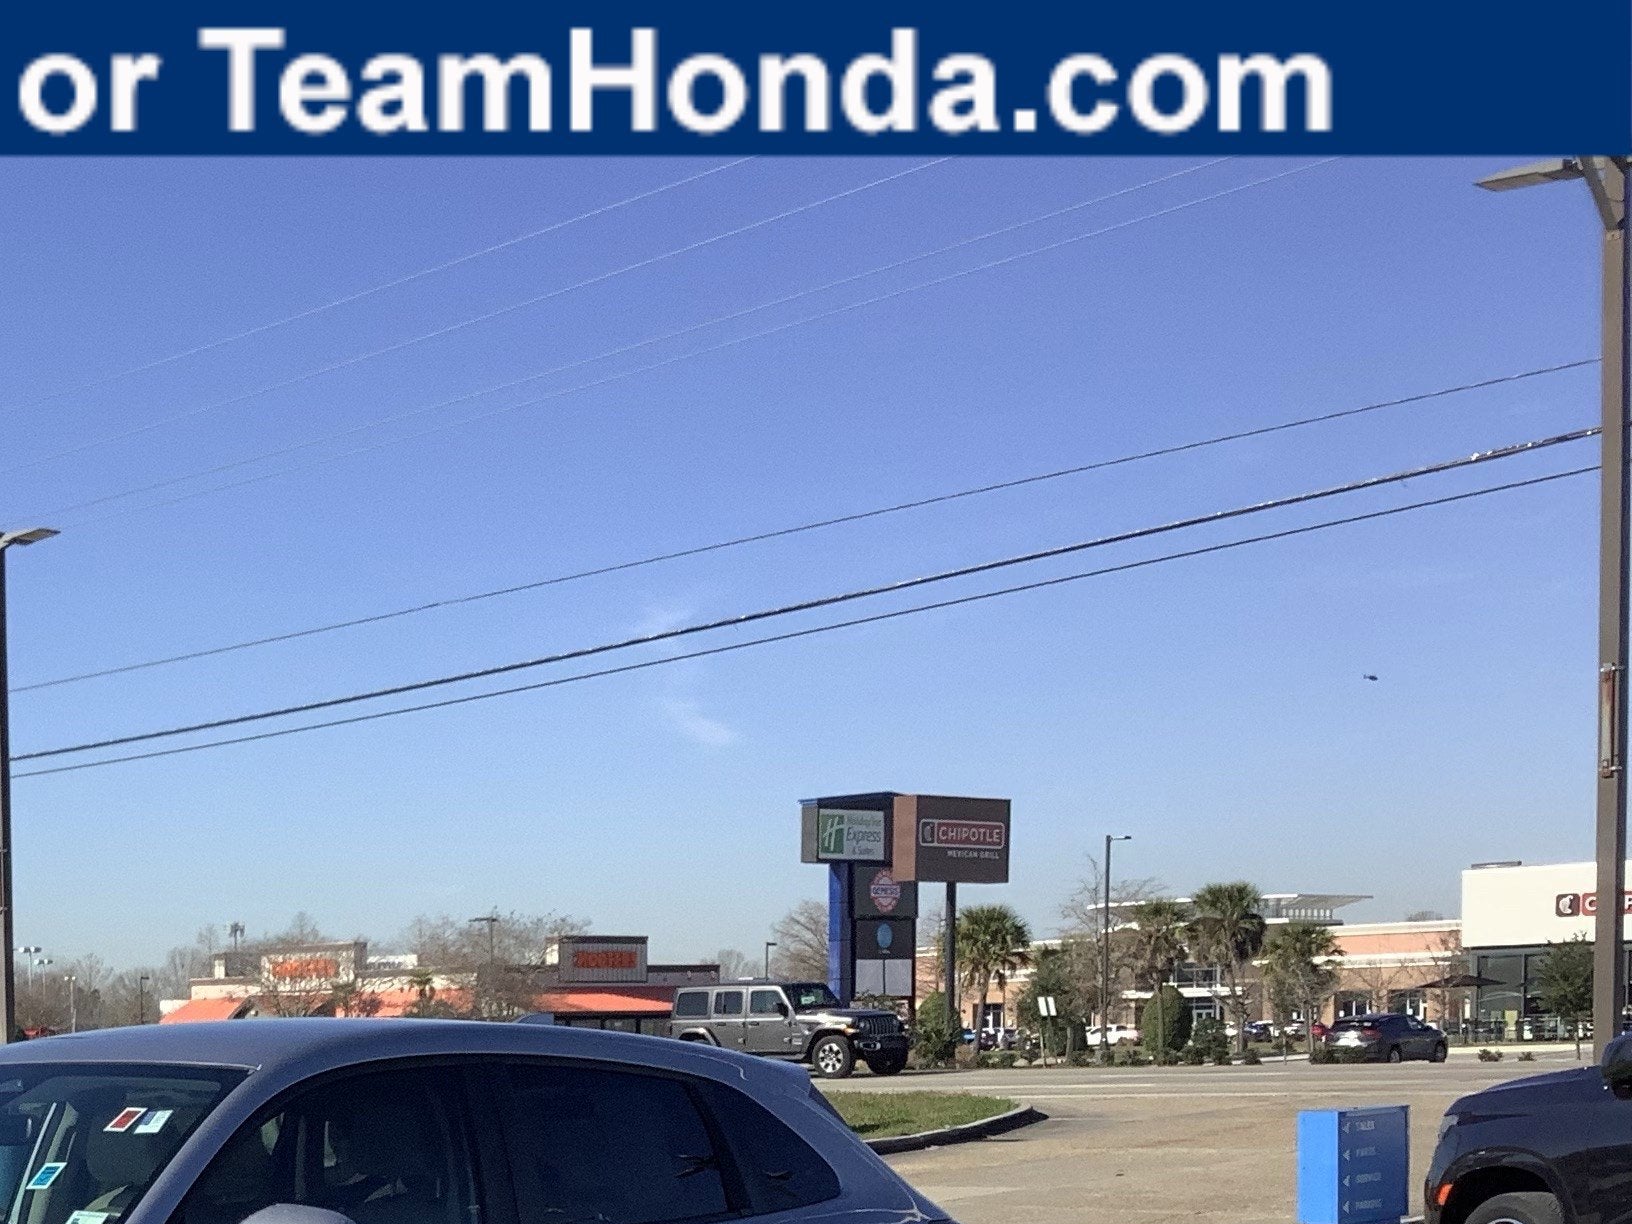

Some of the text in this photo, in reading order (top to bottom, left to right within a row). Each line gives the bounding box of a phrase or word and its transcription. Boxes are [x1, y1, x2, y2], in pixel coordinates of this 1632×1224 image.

[847, 827, 882, 845] Express
[938, 826, 1001, 842] CHIPOTLE
[947, 850, 978, 858] MEXICAN
